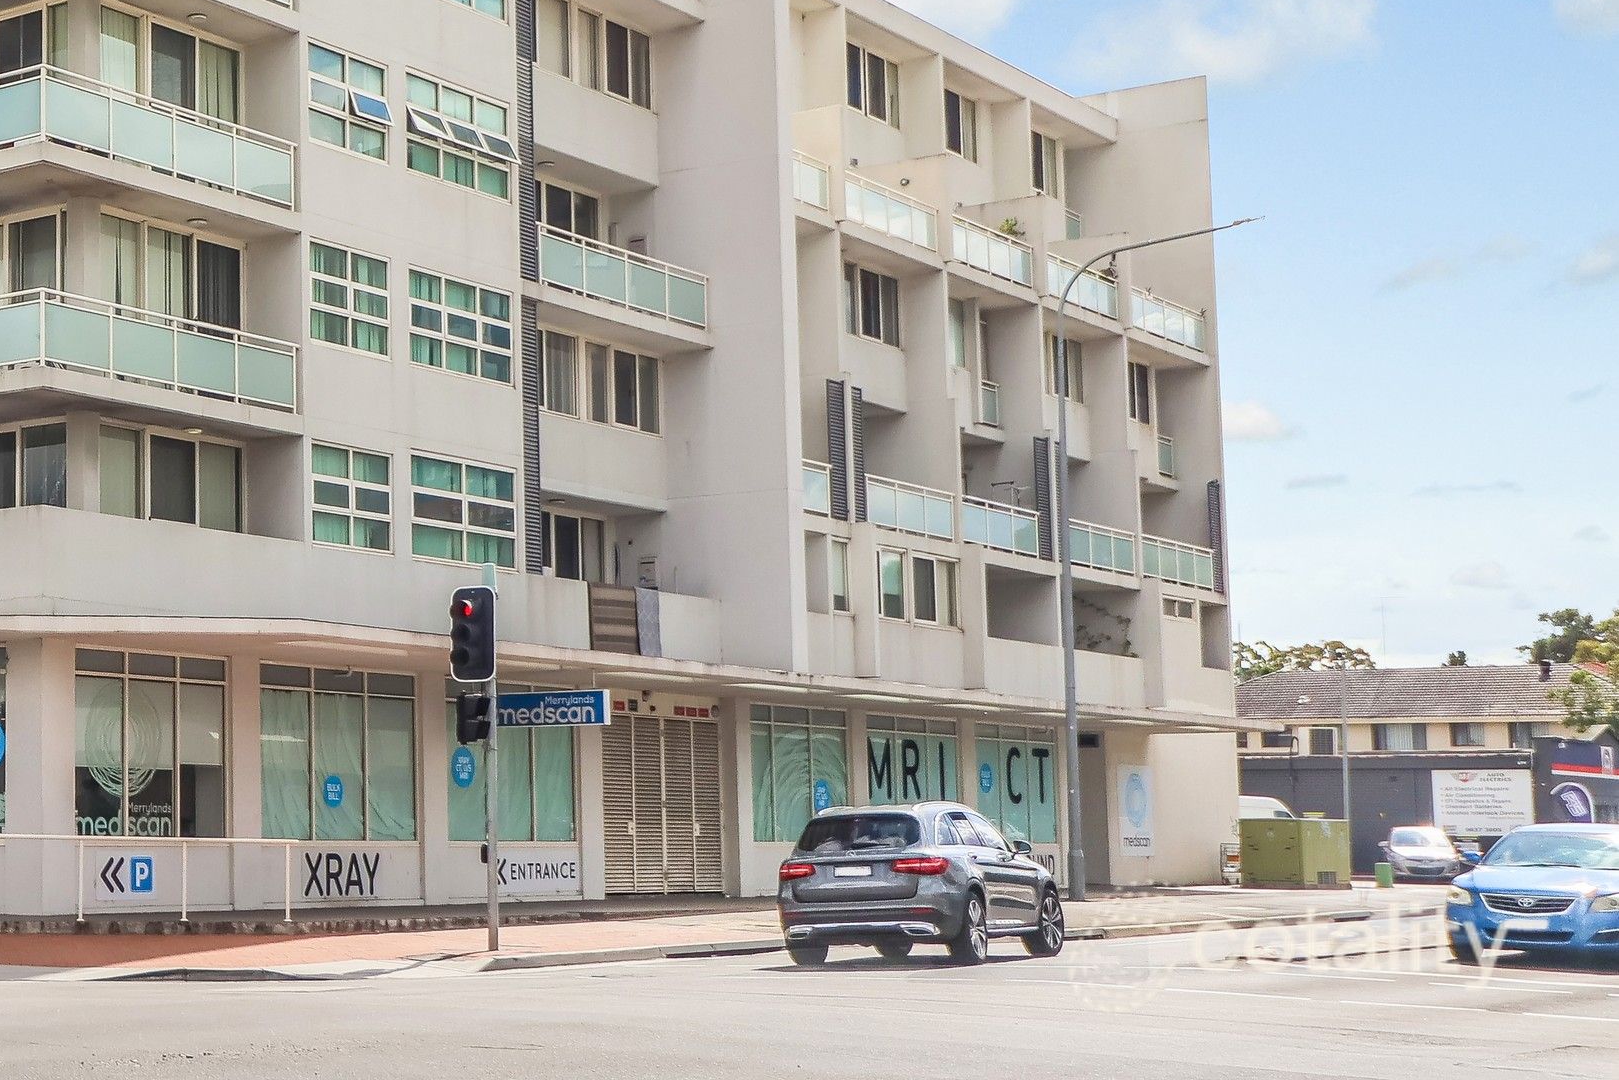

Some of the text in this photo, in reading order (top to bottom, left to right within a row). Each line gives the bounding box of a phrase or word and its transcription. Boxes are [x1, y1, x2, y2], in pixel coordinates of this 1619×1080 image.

[497, 701, 596, 725] medscan
[544, 695, 596, 707] Merrylands
[1006, 746, 1050, 805] CT
[75, 809, 172, 837] medscan
[135, 861, 150, 888] P
[303, 851, 380, 897] XRAY
[510, 861, 577, 881] ENTRANCE
